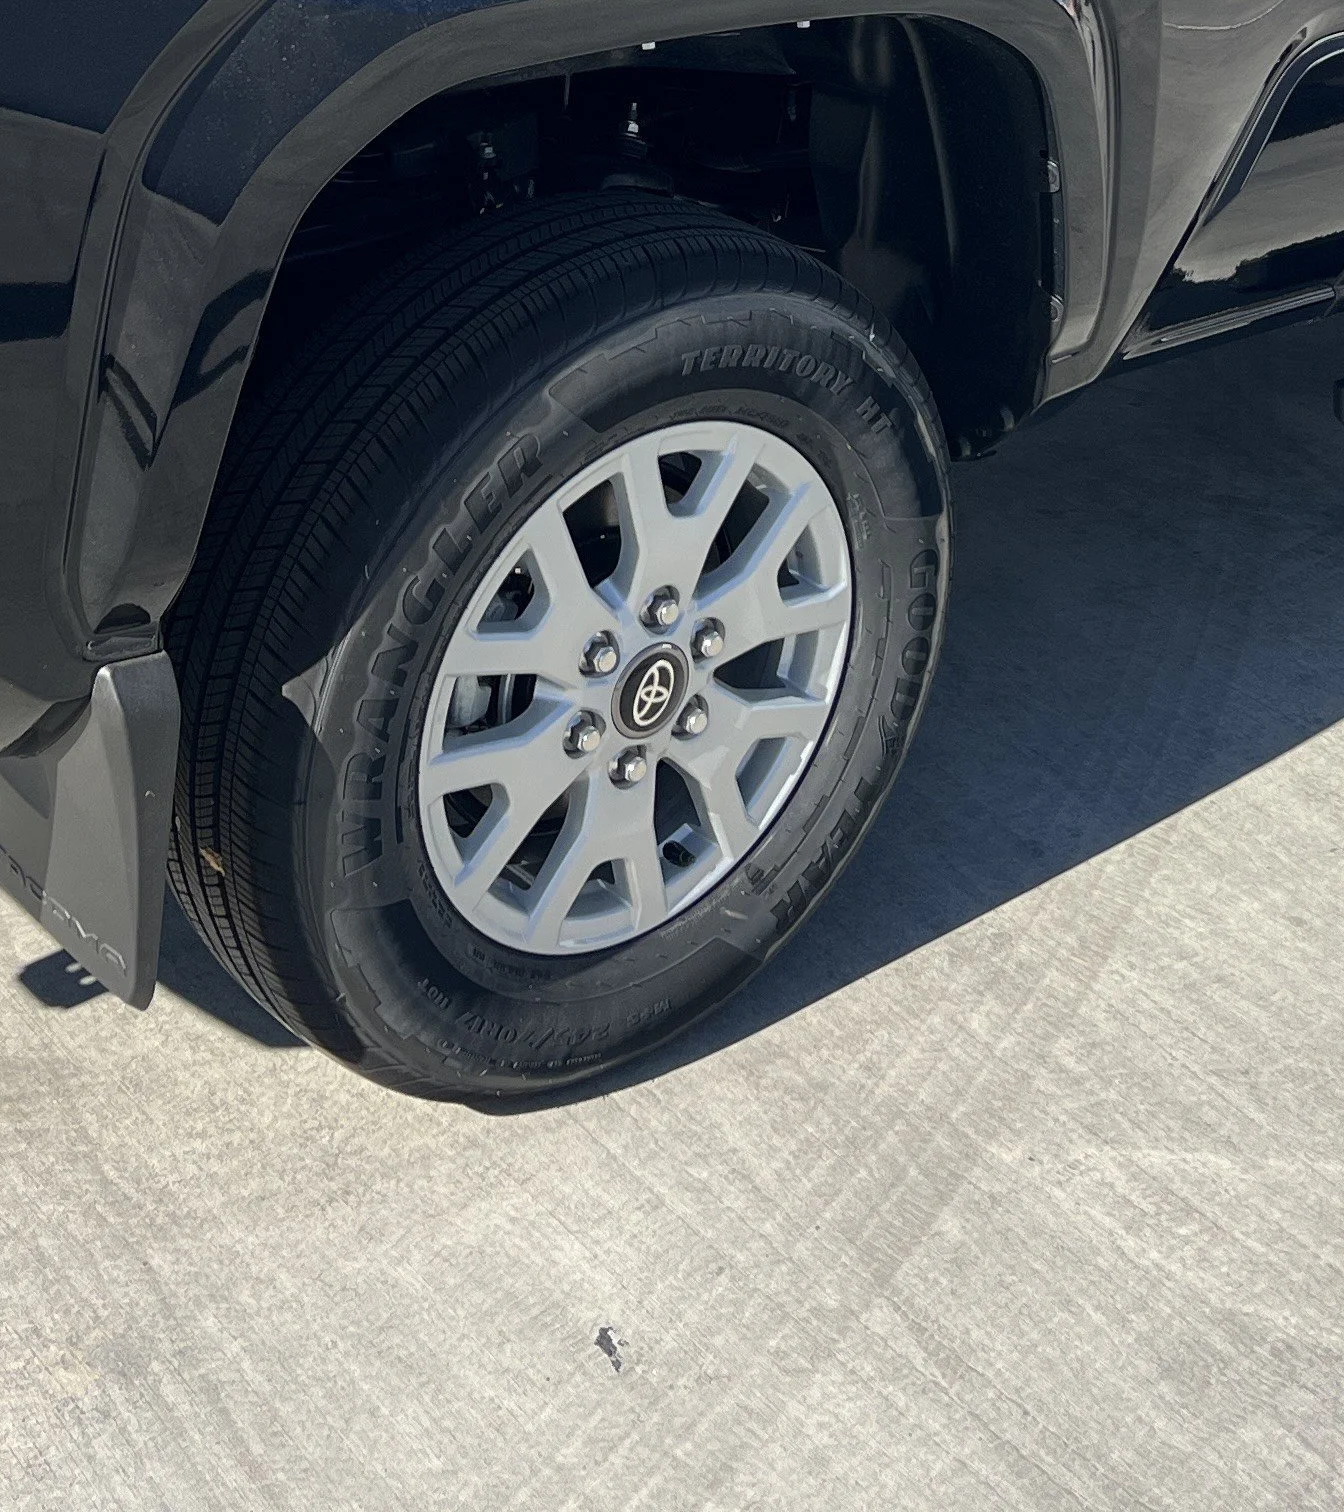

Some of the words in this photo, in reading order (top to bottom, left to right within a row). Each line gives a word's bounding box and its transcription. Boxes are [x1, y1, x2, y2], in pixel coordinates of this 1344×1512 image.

[681, 344, 854, 396] TERRITORY
[856, 396, 898, 436] HT
[341, 432, 543, 878] WRANGLER
[770, 548, 940, 932] GOODYEAR
